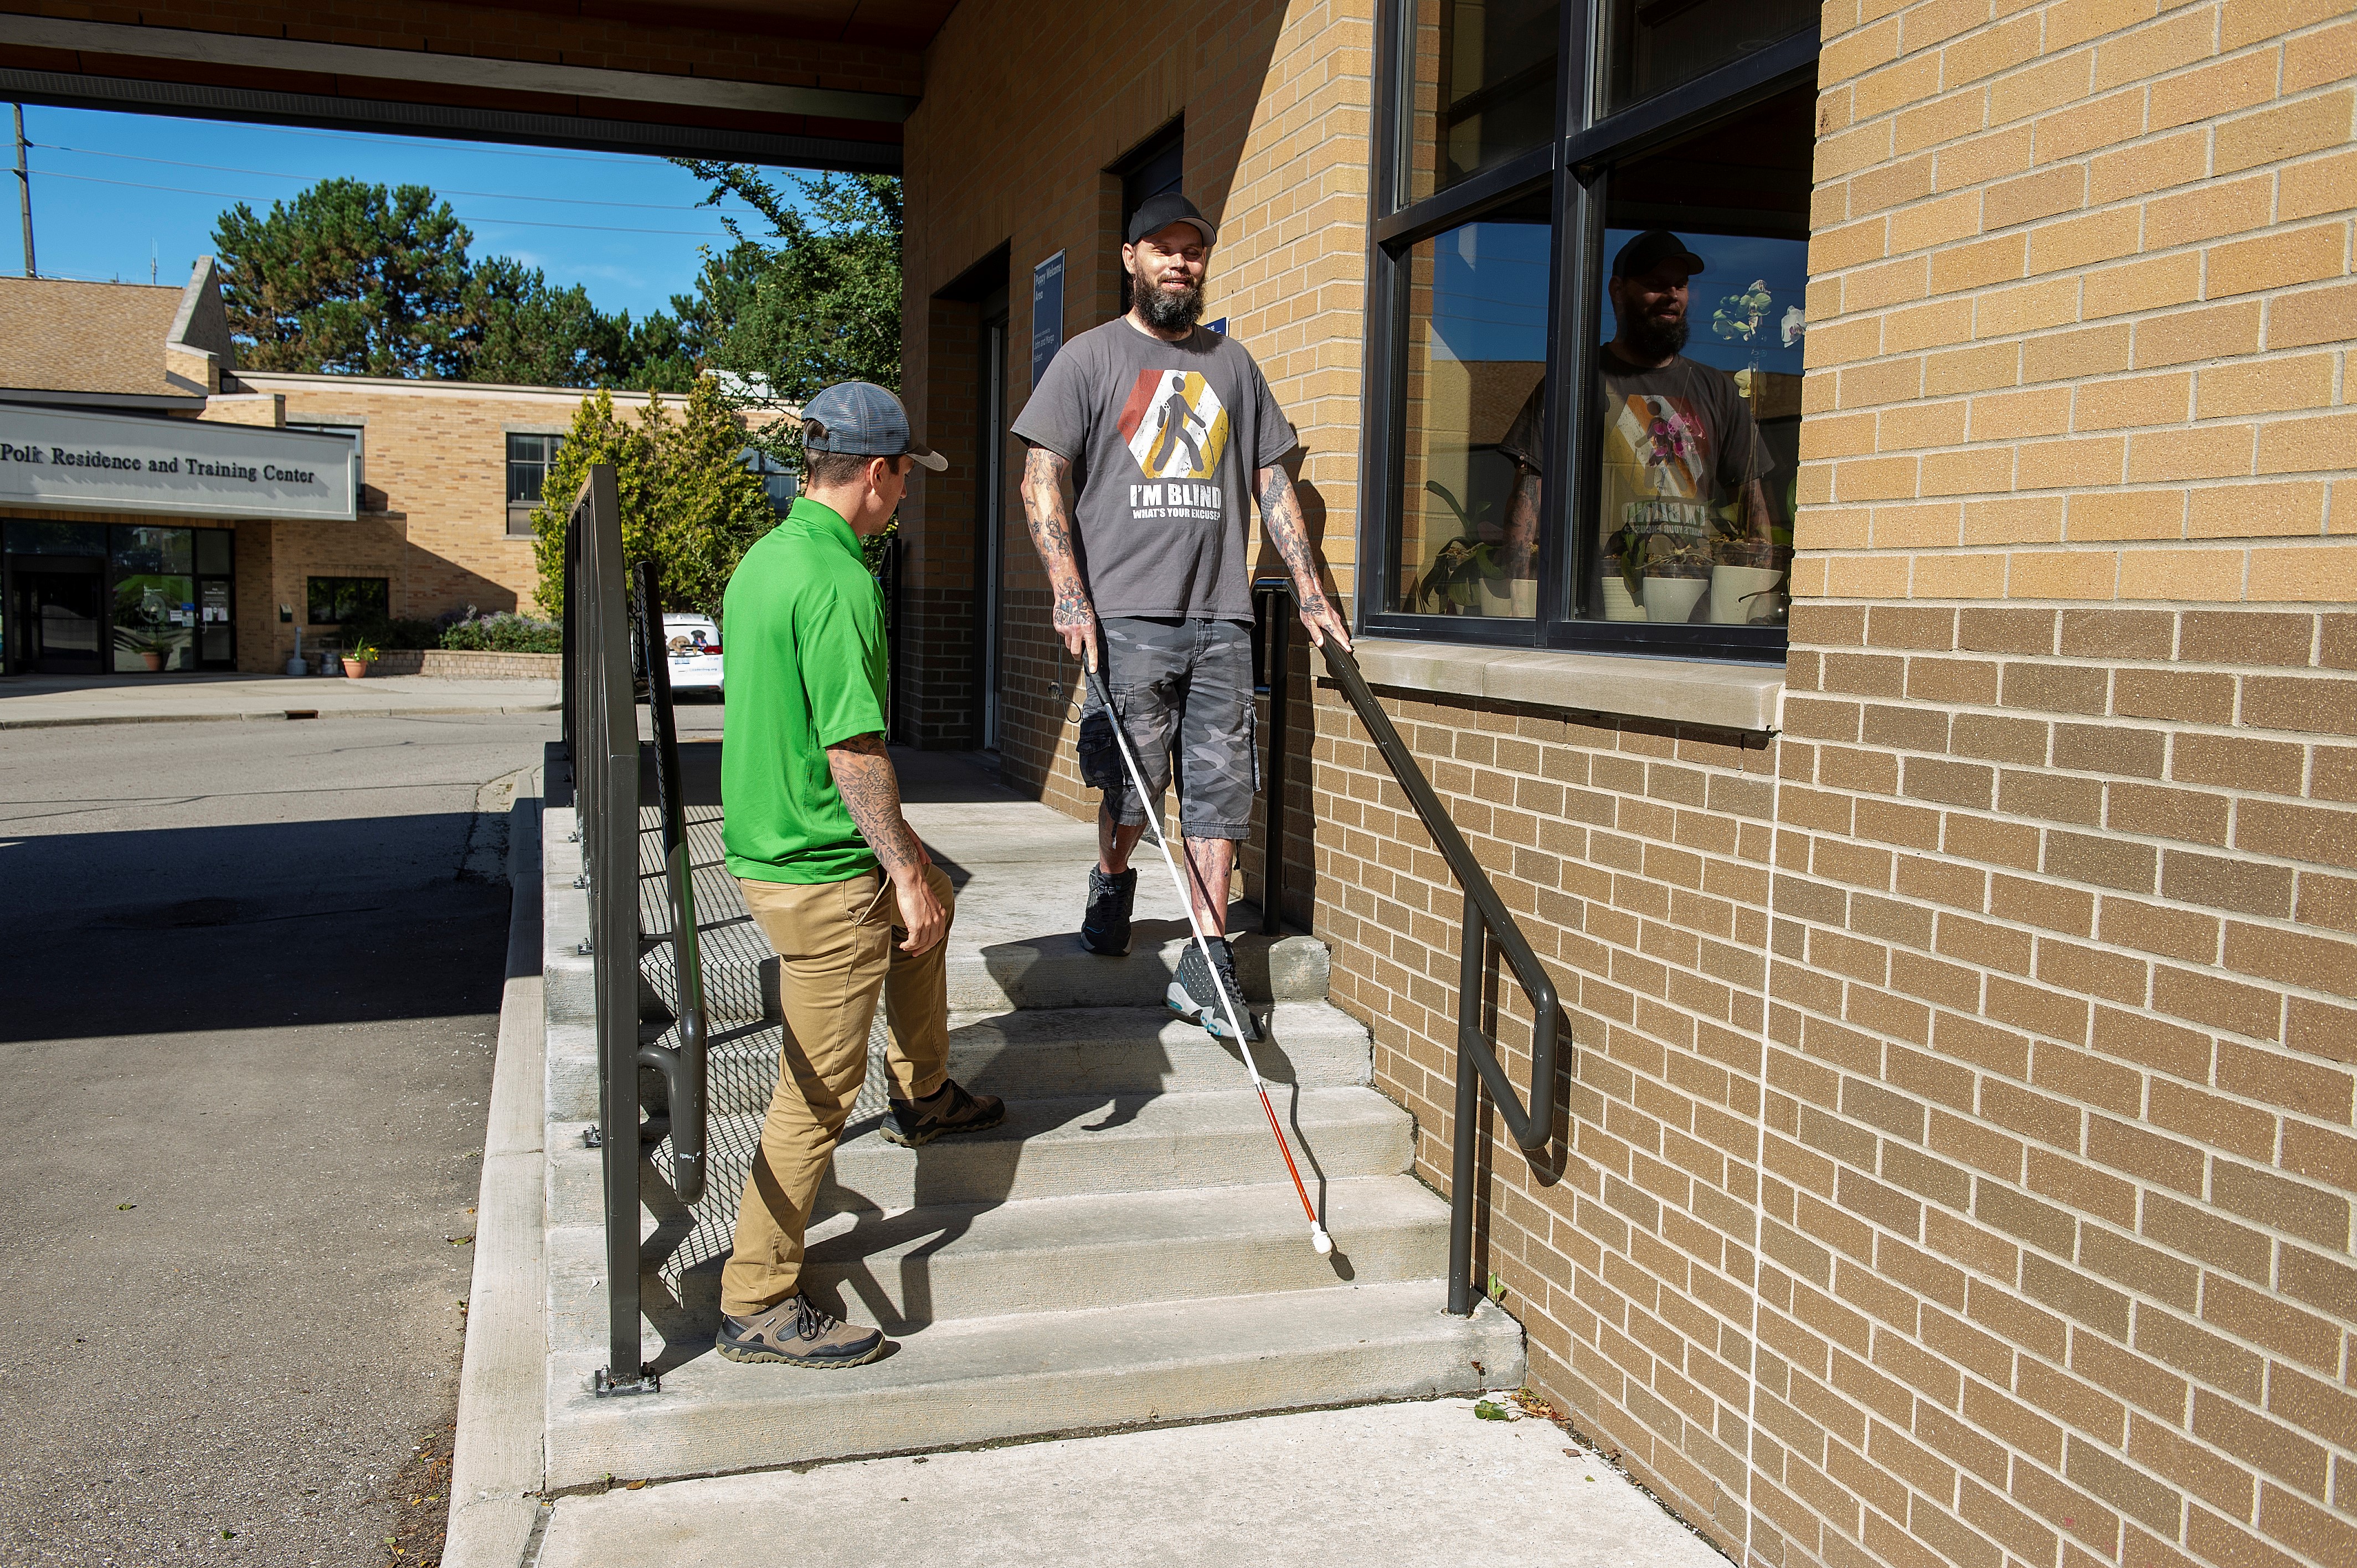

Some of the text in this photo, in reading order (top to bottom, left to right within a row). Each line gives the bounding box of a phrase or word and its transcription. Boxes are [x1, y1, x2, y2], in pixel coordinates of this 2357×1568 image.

[1035, 264, 1062, 287] Puppy Welcome
[1035, 291, 1043, 302] Area
[1, 443, 314, 483] Polk Residence and Training Center
[1130, 483, 1222, 509] I'M BLIND
[1133, 508, 1221, 521] WHAT'S YOUR EXCUSE?
[843, 784, 853, 796] IT'S
[853, 797, 864, 808] NOT
[874, 835, 887, 845] NOT
[886, 845, 898, 857] THE
